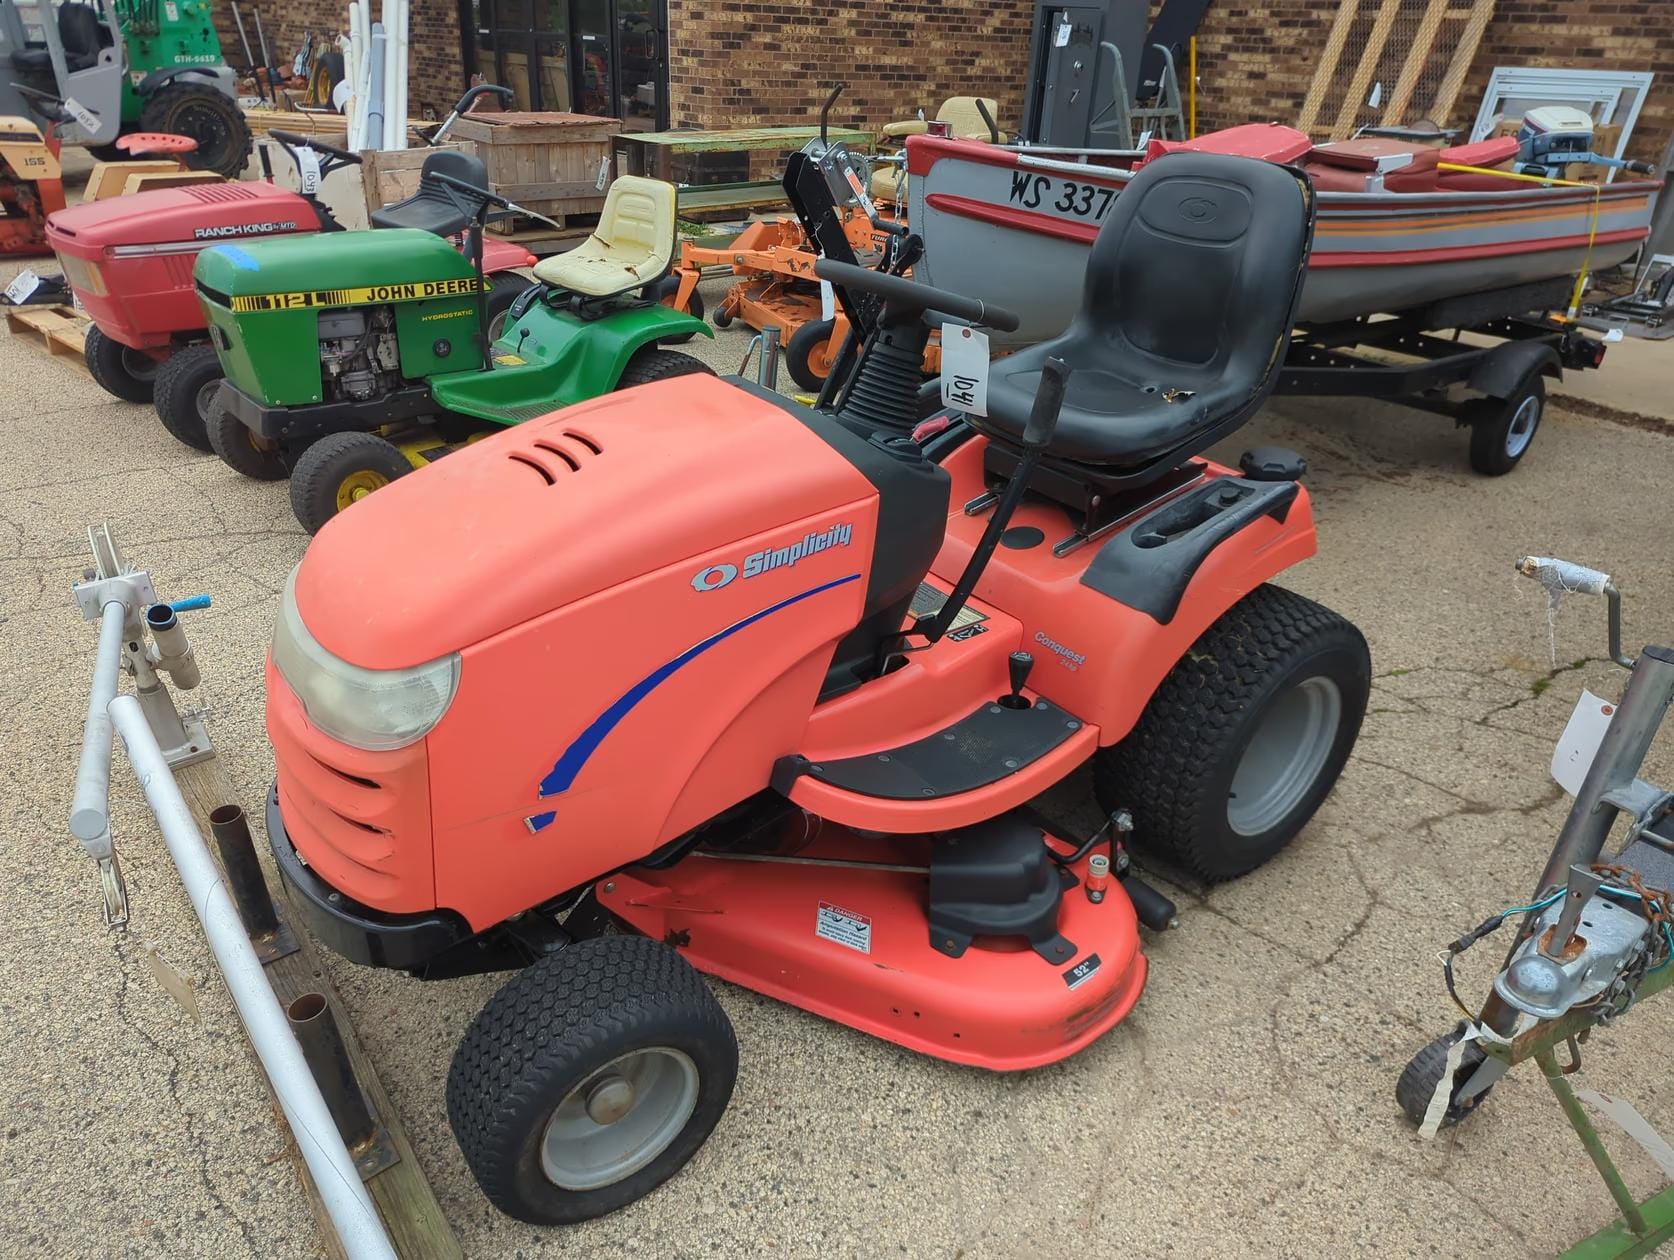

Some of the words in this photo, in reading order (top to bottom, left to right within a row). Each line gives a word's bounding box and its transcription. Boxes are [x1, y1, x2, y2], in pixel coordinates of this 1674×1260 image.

[24, 156, 46, 166] 155
[1010, 171, 1051, 208] WS
[195, 225, 242, 238] RANCH
[243, 222, 273, 234] KING
[366, 284, 416, 301] JOHN
[423, 278, 478, 296] DEERE
[422, 309, 473, 321] HYDROSTATIC
[951, 375, 979, 406] 1041
[742, 523, 852, 579] Simplicity
[1034, 630, 1086, 665] Conquest
[835, 908, 863, 921] DANGER
